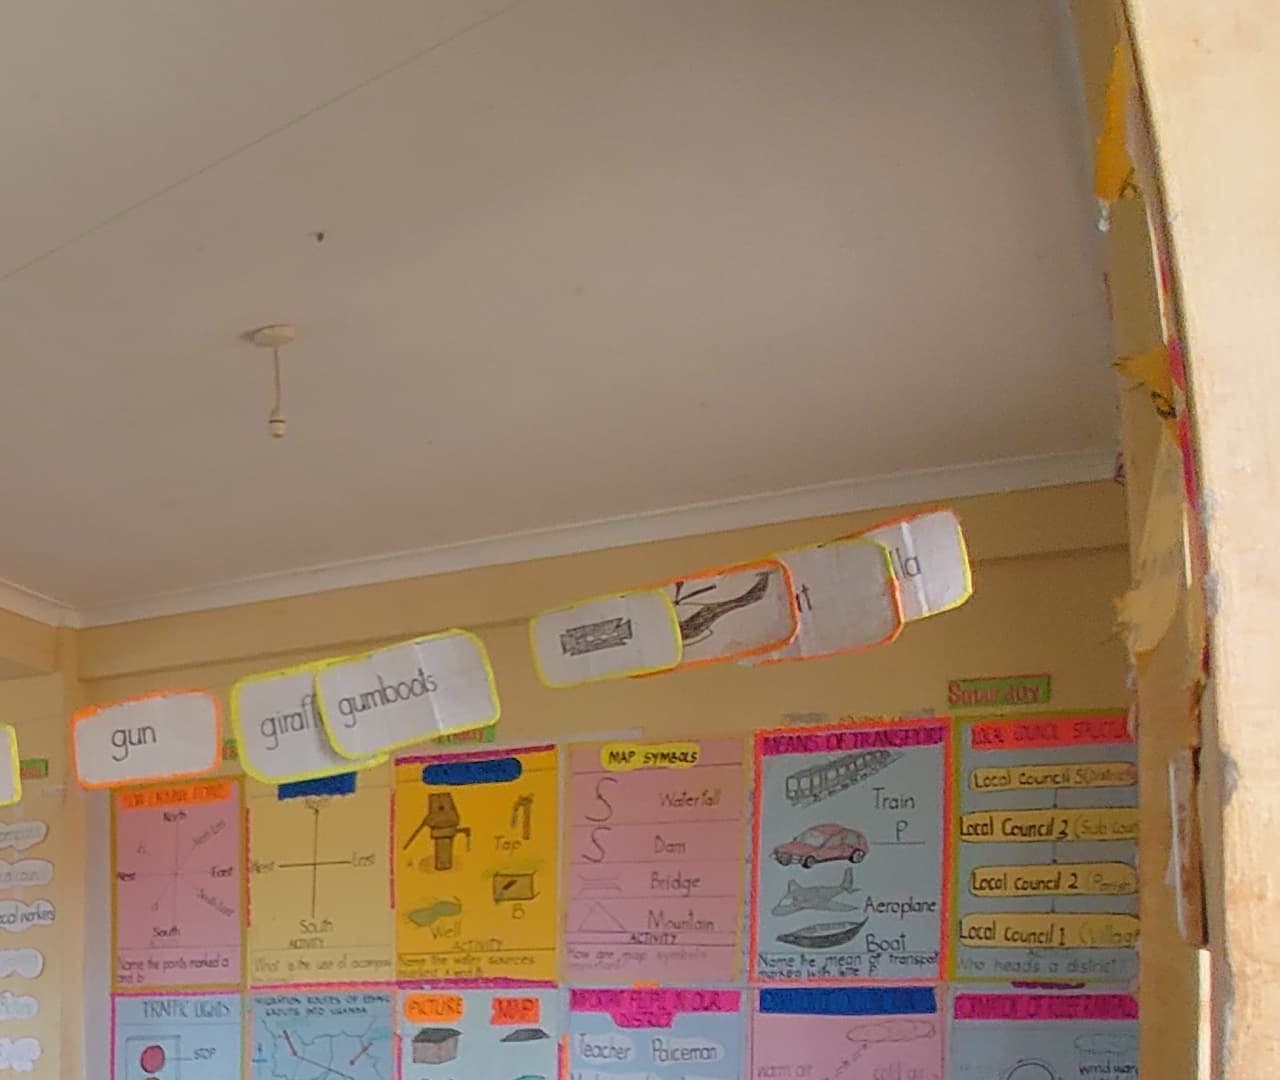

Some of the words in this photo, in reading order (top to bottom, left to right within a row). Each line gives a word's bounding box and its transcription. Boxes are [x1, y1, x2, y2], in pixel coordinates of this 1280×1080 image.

[339, 667, 438, 729] gumboots
[111, 724, 156, 762] gun
[609, 751, 635, 764] MAP
[644, 751, 697, 764] SYMBOLS
[974, 770, 1011, 788] Local
[873, 788, 916, 810] Train
[896, 820, 908, 841] P
[960, 815, 993, 836] Local
[1002, 816, 1055, 837] Council
[655, 835, 686, 854] Dam
[651, 872, 701, 897] Bridge
[972, 872, 1007, 890] Local
[1068, 873, 1078, 889] 2
[864, 897, 936, 919] Aeroplane
[299, 919, 334, 934] South
[648, 909, 714, 931] Mountain
[960, 919, 996, 940] Local
[865, 934, 907, 953] Boat
[579, 1033, 632, 1060] Teacher
[652, 1038, 718, 1062] Policeman
